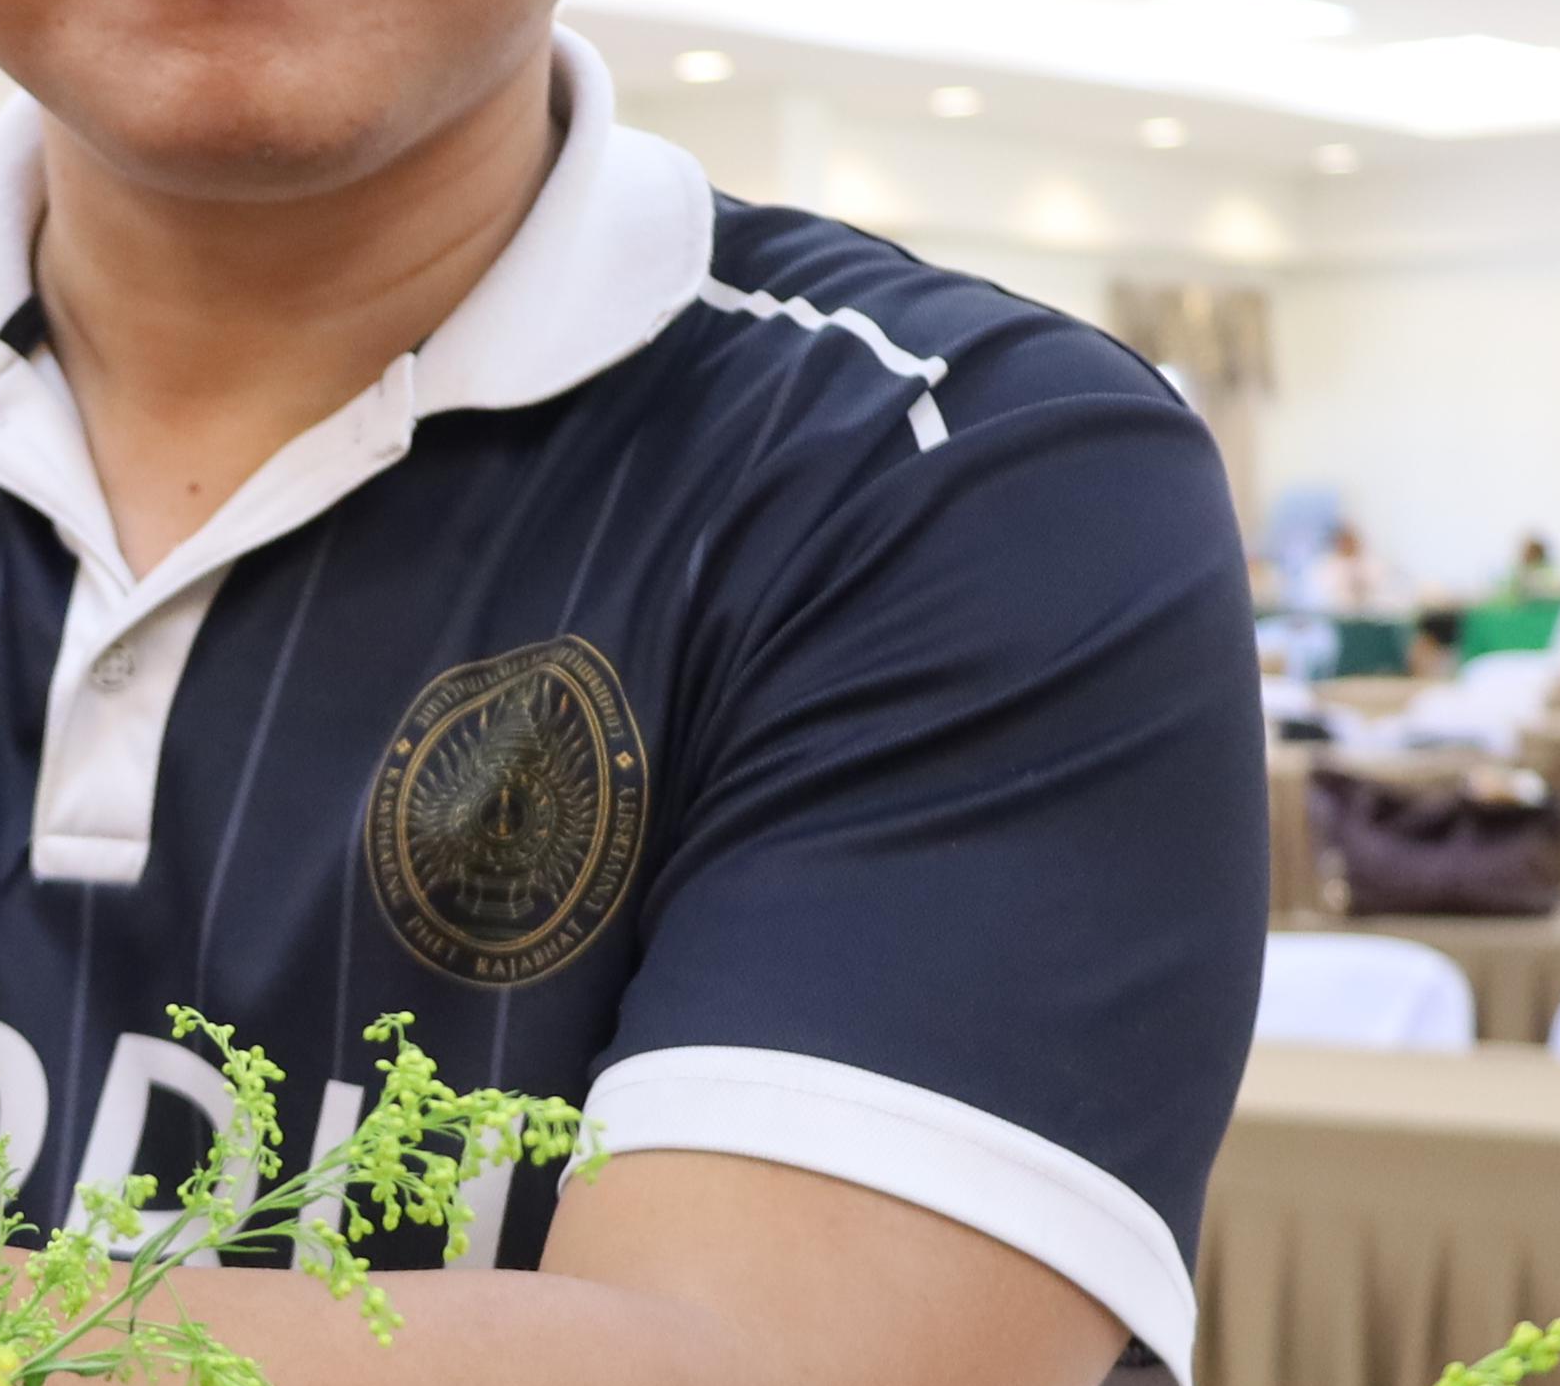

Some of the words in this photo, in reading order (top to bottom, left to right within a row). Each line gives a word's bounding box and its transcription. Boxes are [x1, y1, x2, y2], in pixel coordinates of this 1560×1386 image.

[406, 915, 459, 961] PHET
[476, 918, 584, 979] RAJABHAT
[584, 785, 637, 912] UNIVERSITY
